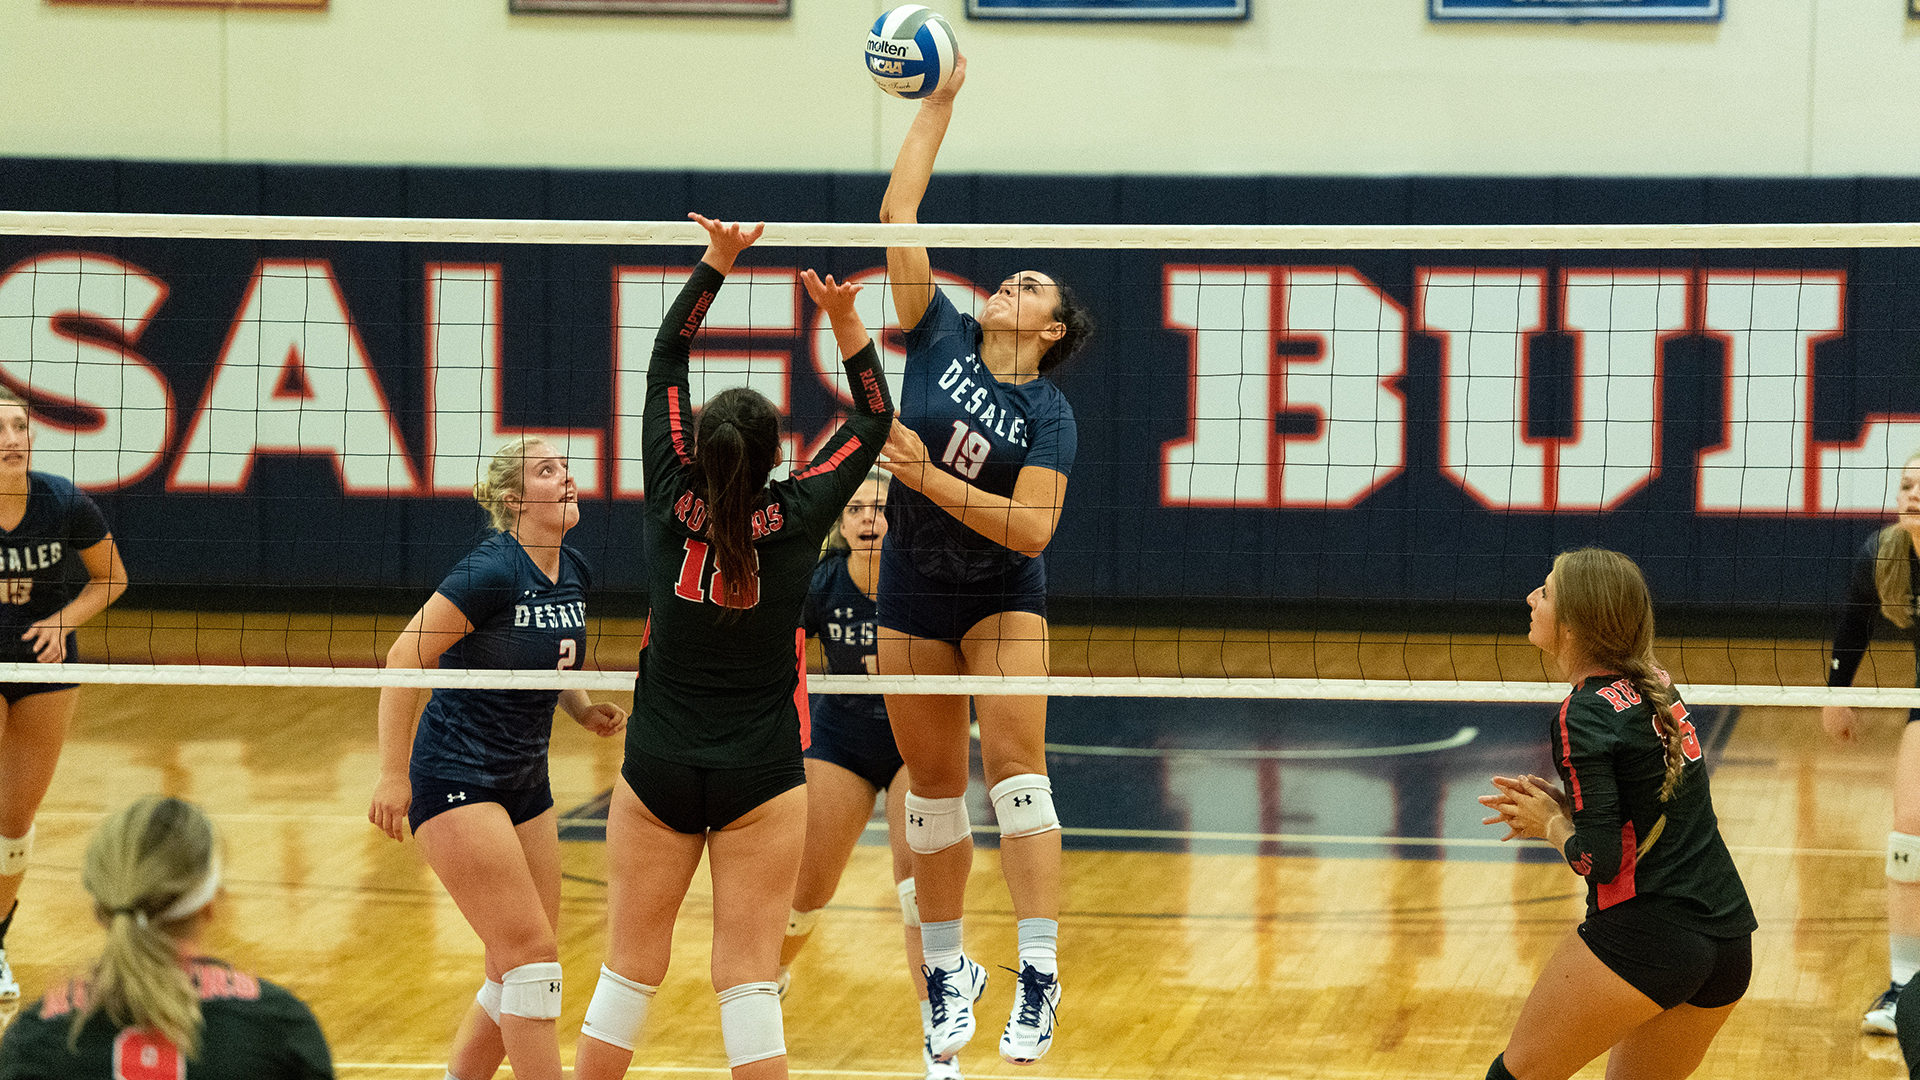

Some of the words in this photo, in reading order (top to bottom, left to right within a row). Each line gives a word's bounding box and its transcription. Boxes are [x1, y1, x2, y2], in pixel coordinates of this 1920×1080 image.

[867, 39, 906, 57] molten
[869, 56, 903, 75] NCAA
[680, 290, 714, 337] RAPTORS
[941, 419, 992, 480] 19
[674, 489, 784, 540] RURS
[674, 537, 760, 610] 18
[556, 638, 577, 671] 2
